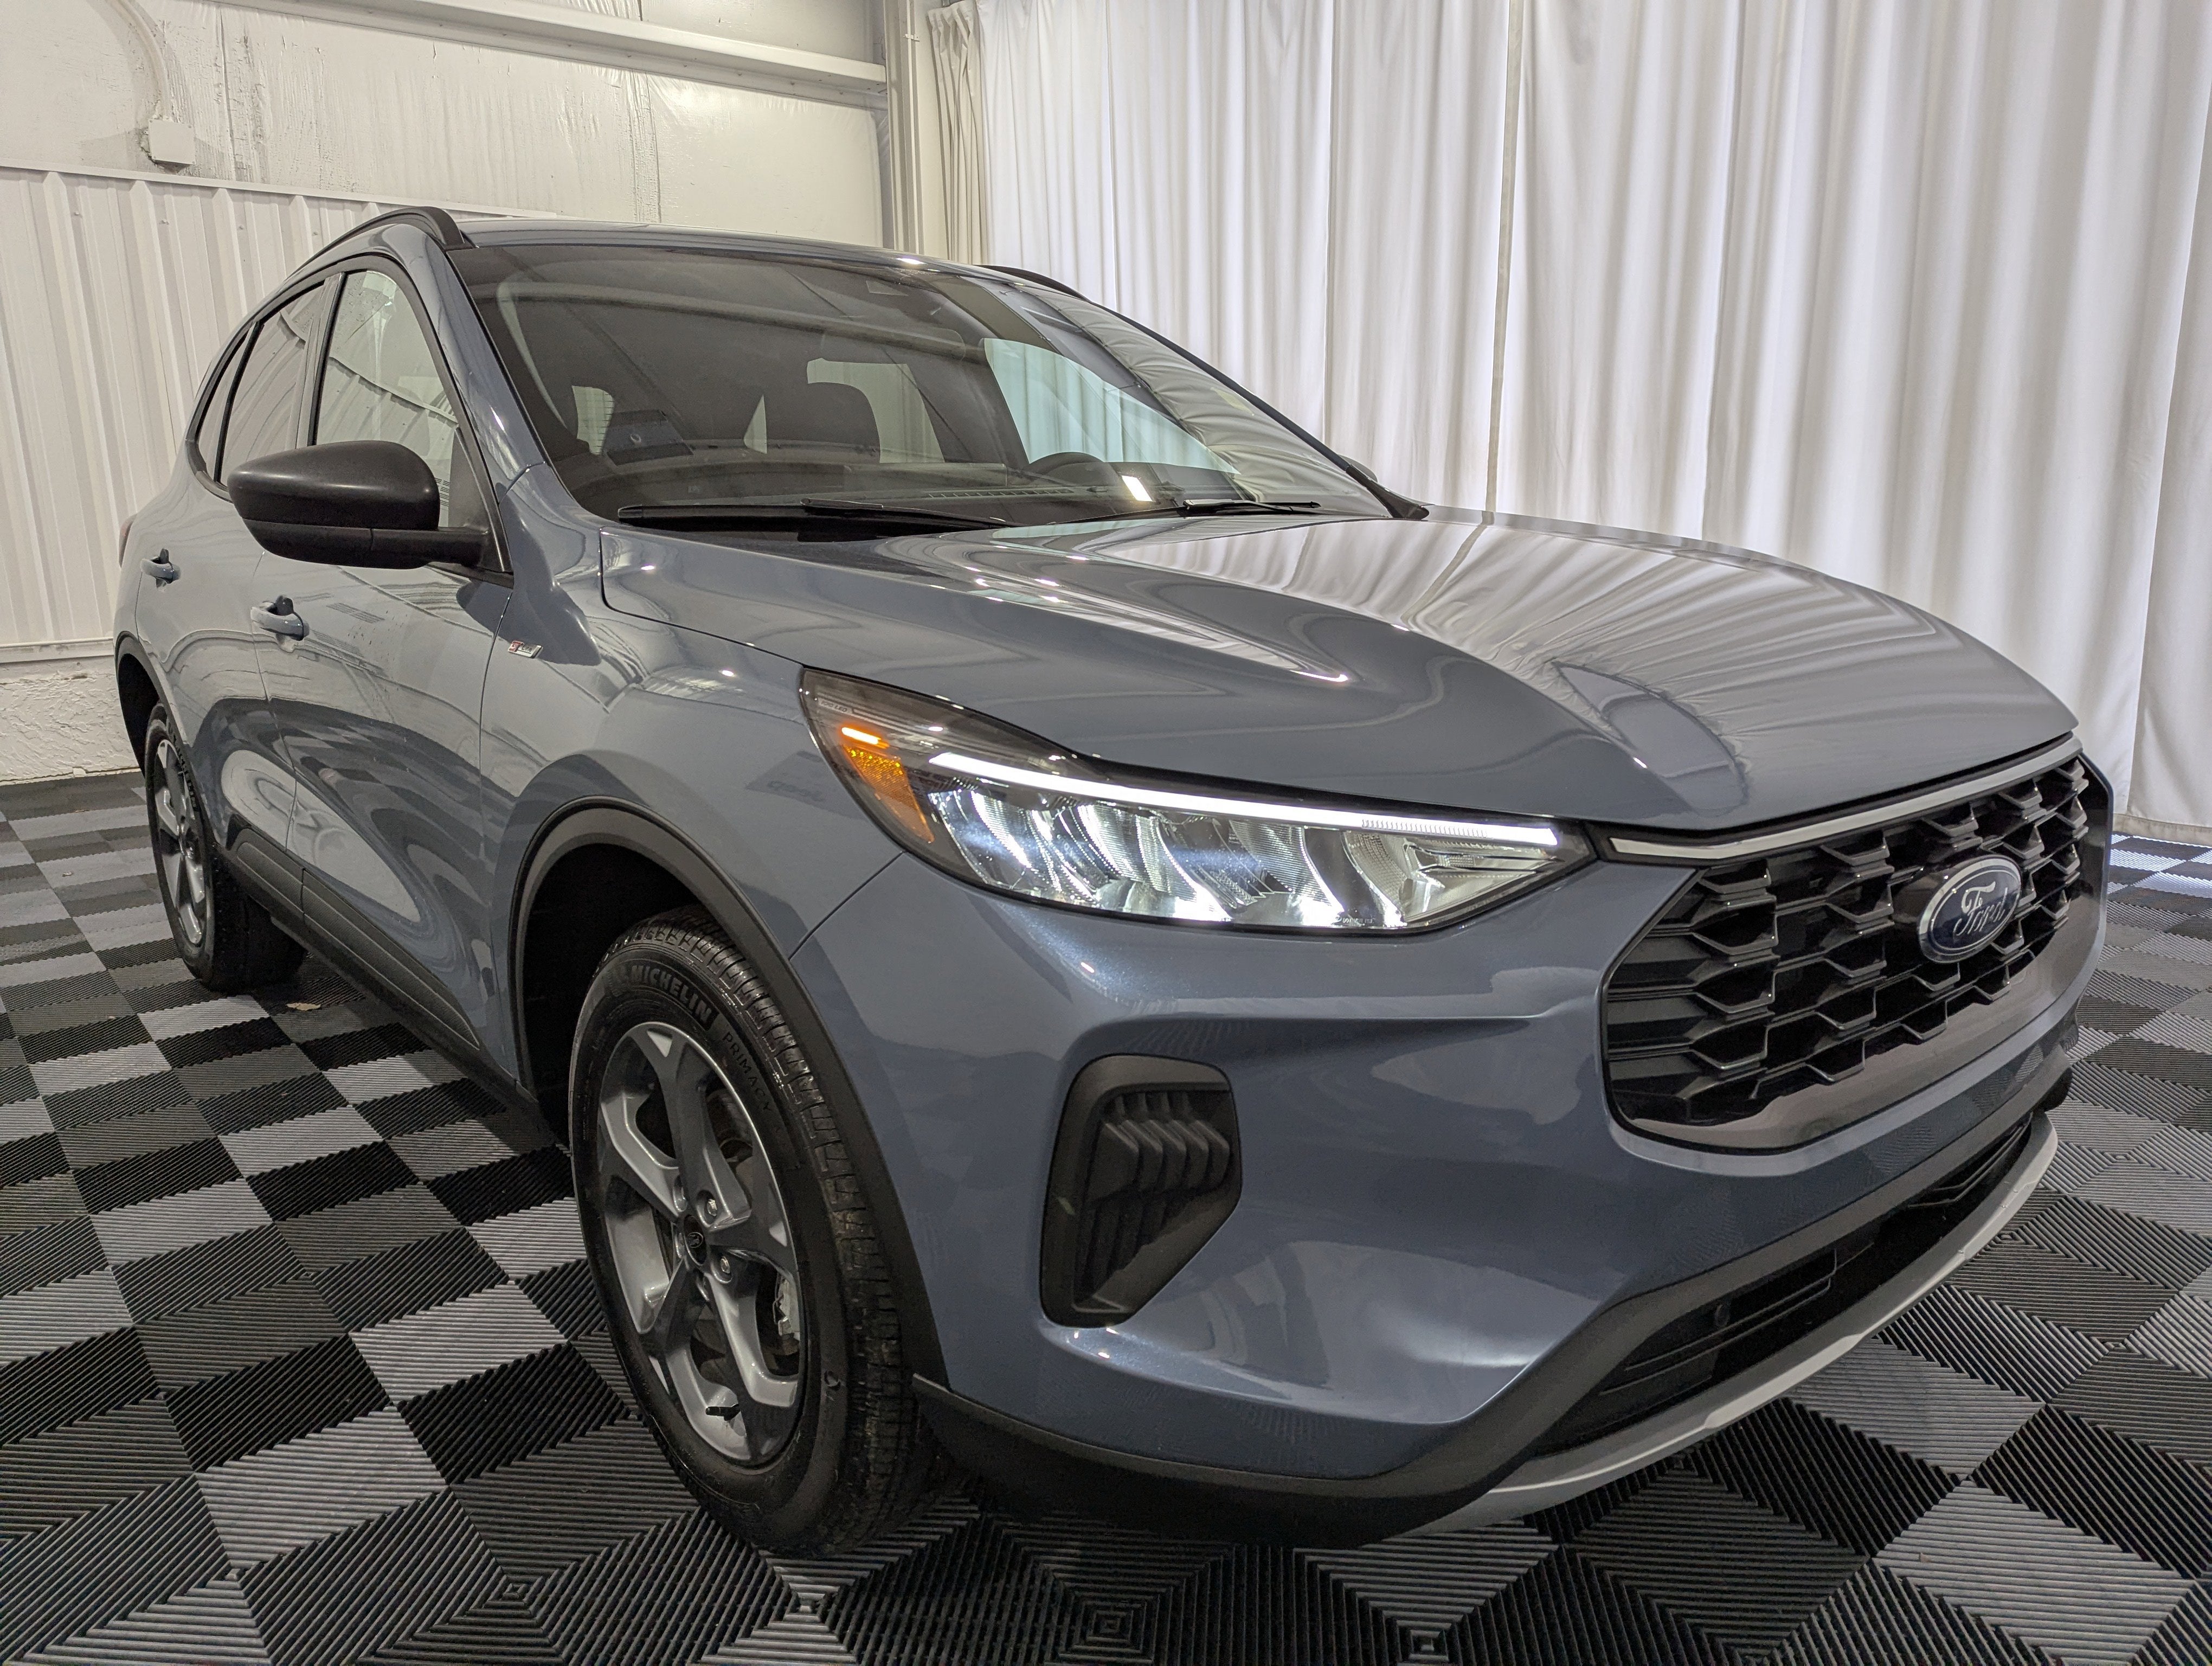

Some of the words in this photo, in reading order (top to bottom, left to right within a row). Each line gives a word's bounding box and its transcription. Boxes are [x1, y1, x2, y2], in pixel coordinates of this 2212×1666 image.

[1952, 881, 2008, 937] Ford
[631, 965, 712, 1021] MICHELIN
[722, 1031, 771, 1112] PRIMACY
